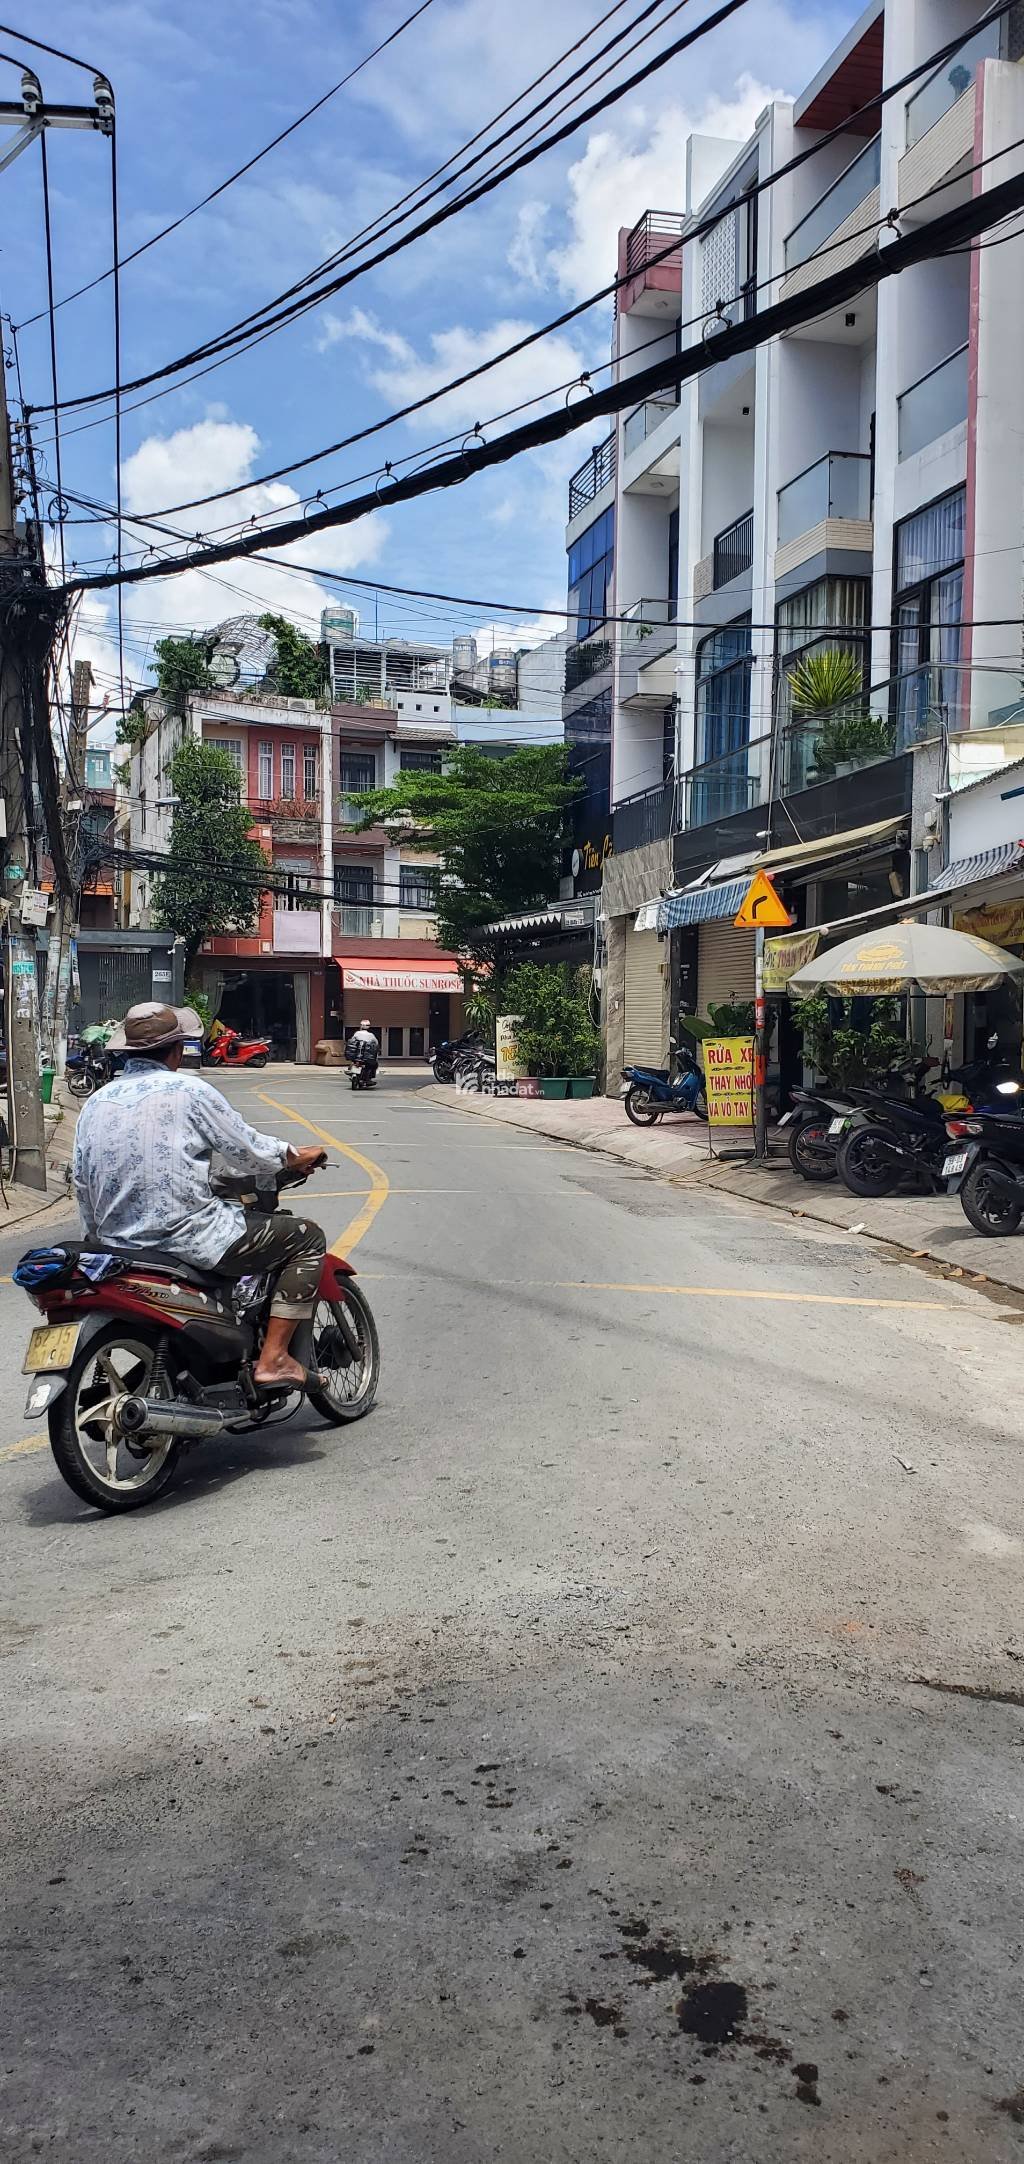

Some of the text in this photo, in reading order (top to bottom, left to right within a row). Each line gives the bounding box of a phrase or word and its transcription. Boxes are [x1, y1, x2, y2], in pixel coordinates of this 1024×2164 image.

[360, 975, 380, 987] NHÀ
[383, 974, 417, 987] THUỐC
[708, 1044, 733, 1064] RỬA
[709, 1075, 731, 1090] THAY
[734, 1102, 749, 1117] TAY
